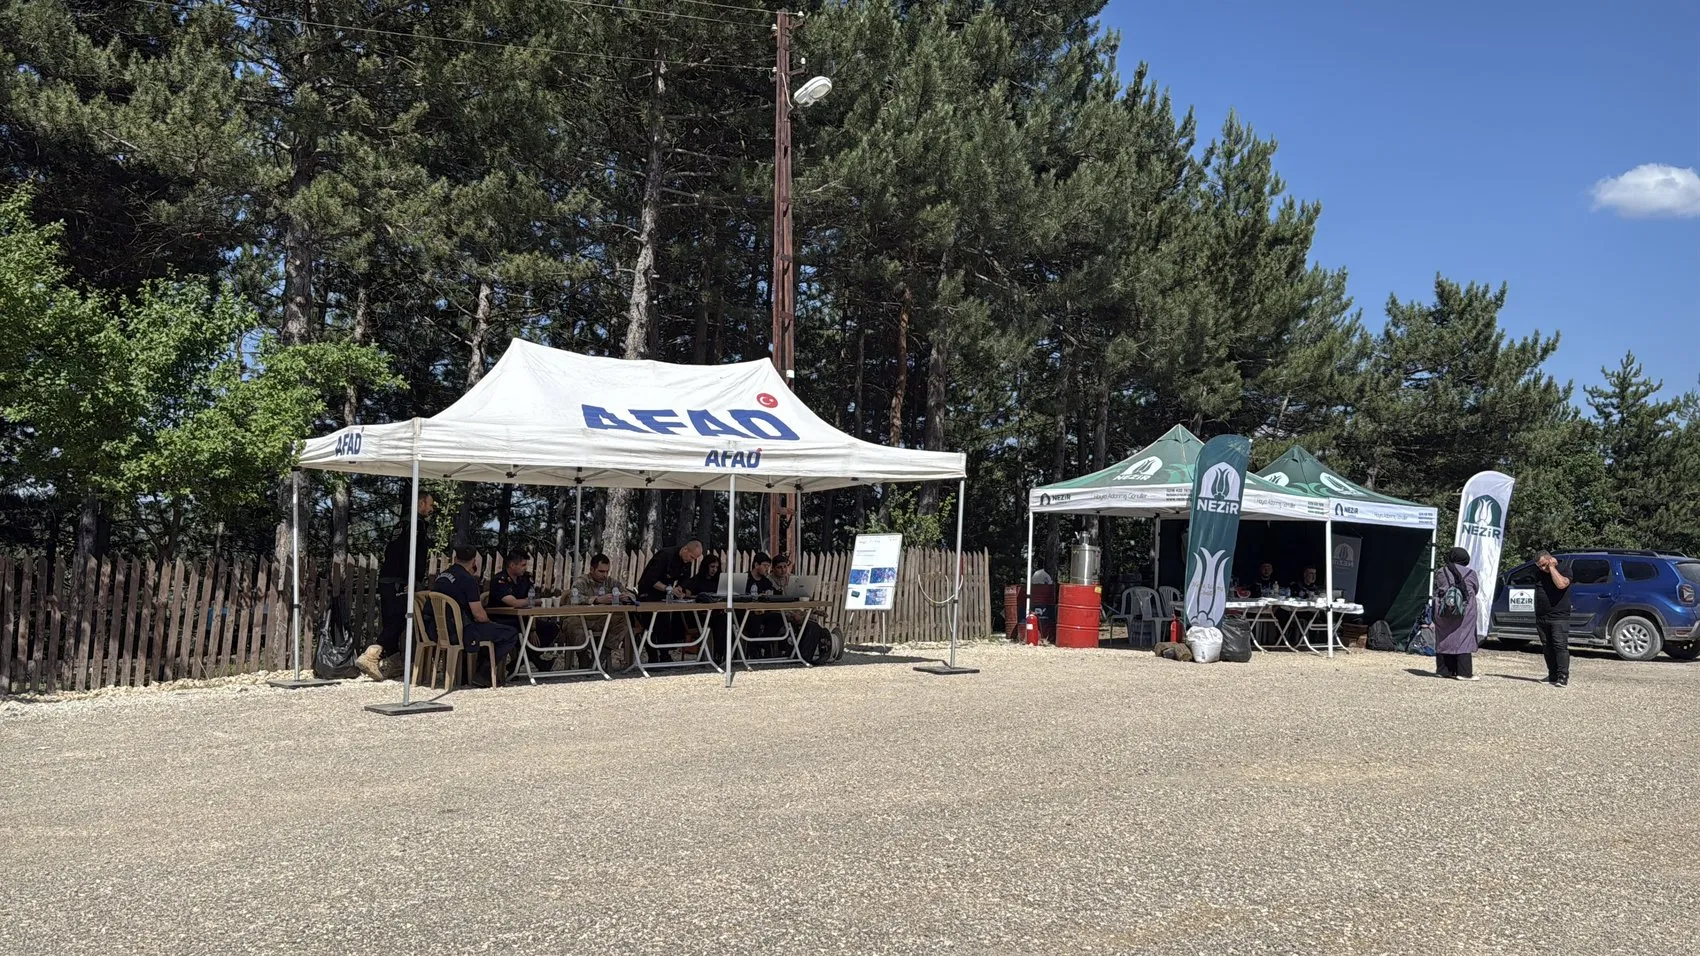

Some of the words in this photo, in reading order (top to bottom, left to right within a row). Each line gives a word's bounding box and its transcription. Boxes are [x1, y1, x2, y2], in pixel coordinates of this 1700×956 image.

[582, 404, 800, 440] AFAD
[335, 433, 362, 456] AFAD
[704, 449, 761, 468] AFAD
